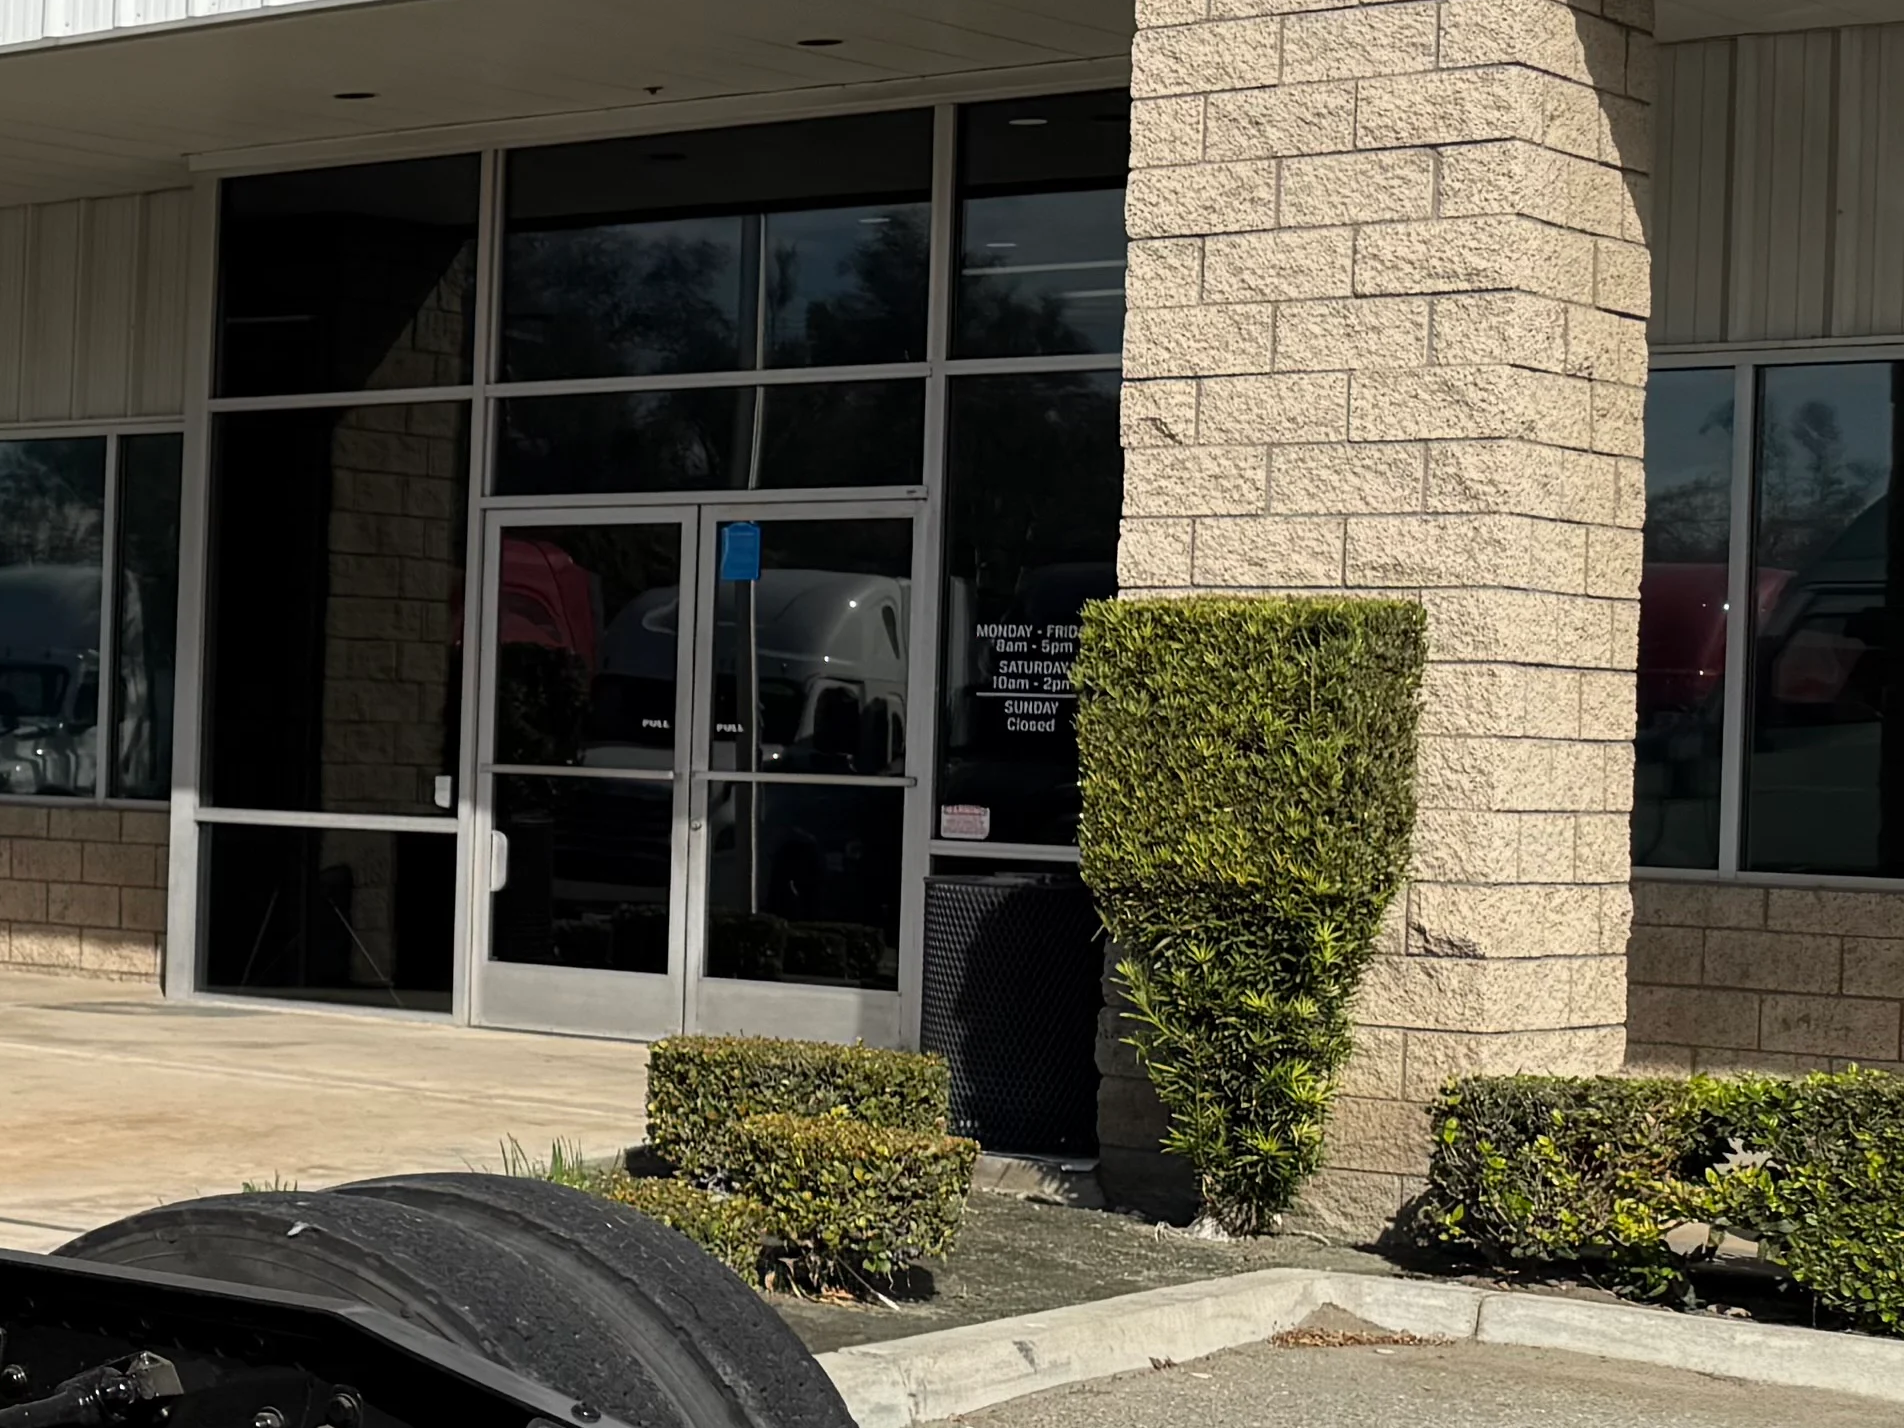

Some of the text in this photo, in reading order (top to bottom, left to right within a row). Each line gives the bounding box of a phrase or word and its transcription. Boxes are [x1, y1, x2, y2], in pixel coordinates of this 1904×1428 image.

[976, 624, 1033, 638] MONDAY
[1047, 624, 1079, 638] FRID
[996, 639, 1028, 652] 8am
[1041, 639, 1073, 655] 5pm
[999, 660, 1070, 674] SATURDAY
[993, 676, 1029, 690] 10am
[1004, 700, 1059, 714] SUNDAY
[642, 719, 670, 729] PULL
[716, 723, 744, 732] PULL
[1007, 717, 1055, 732] Closed
